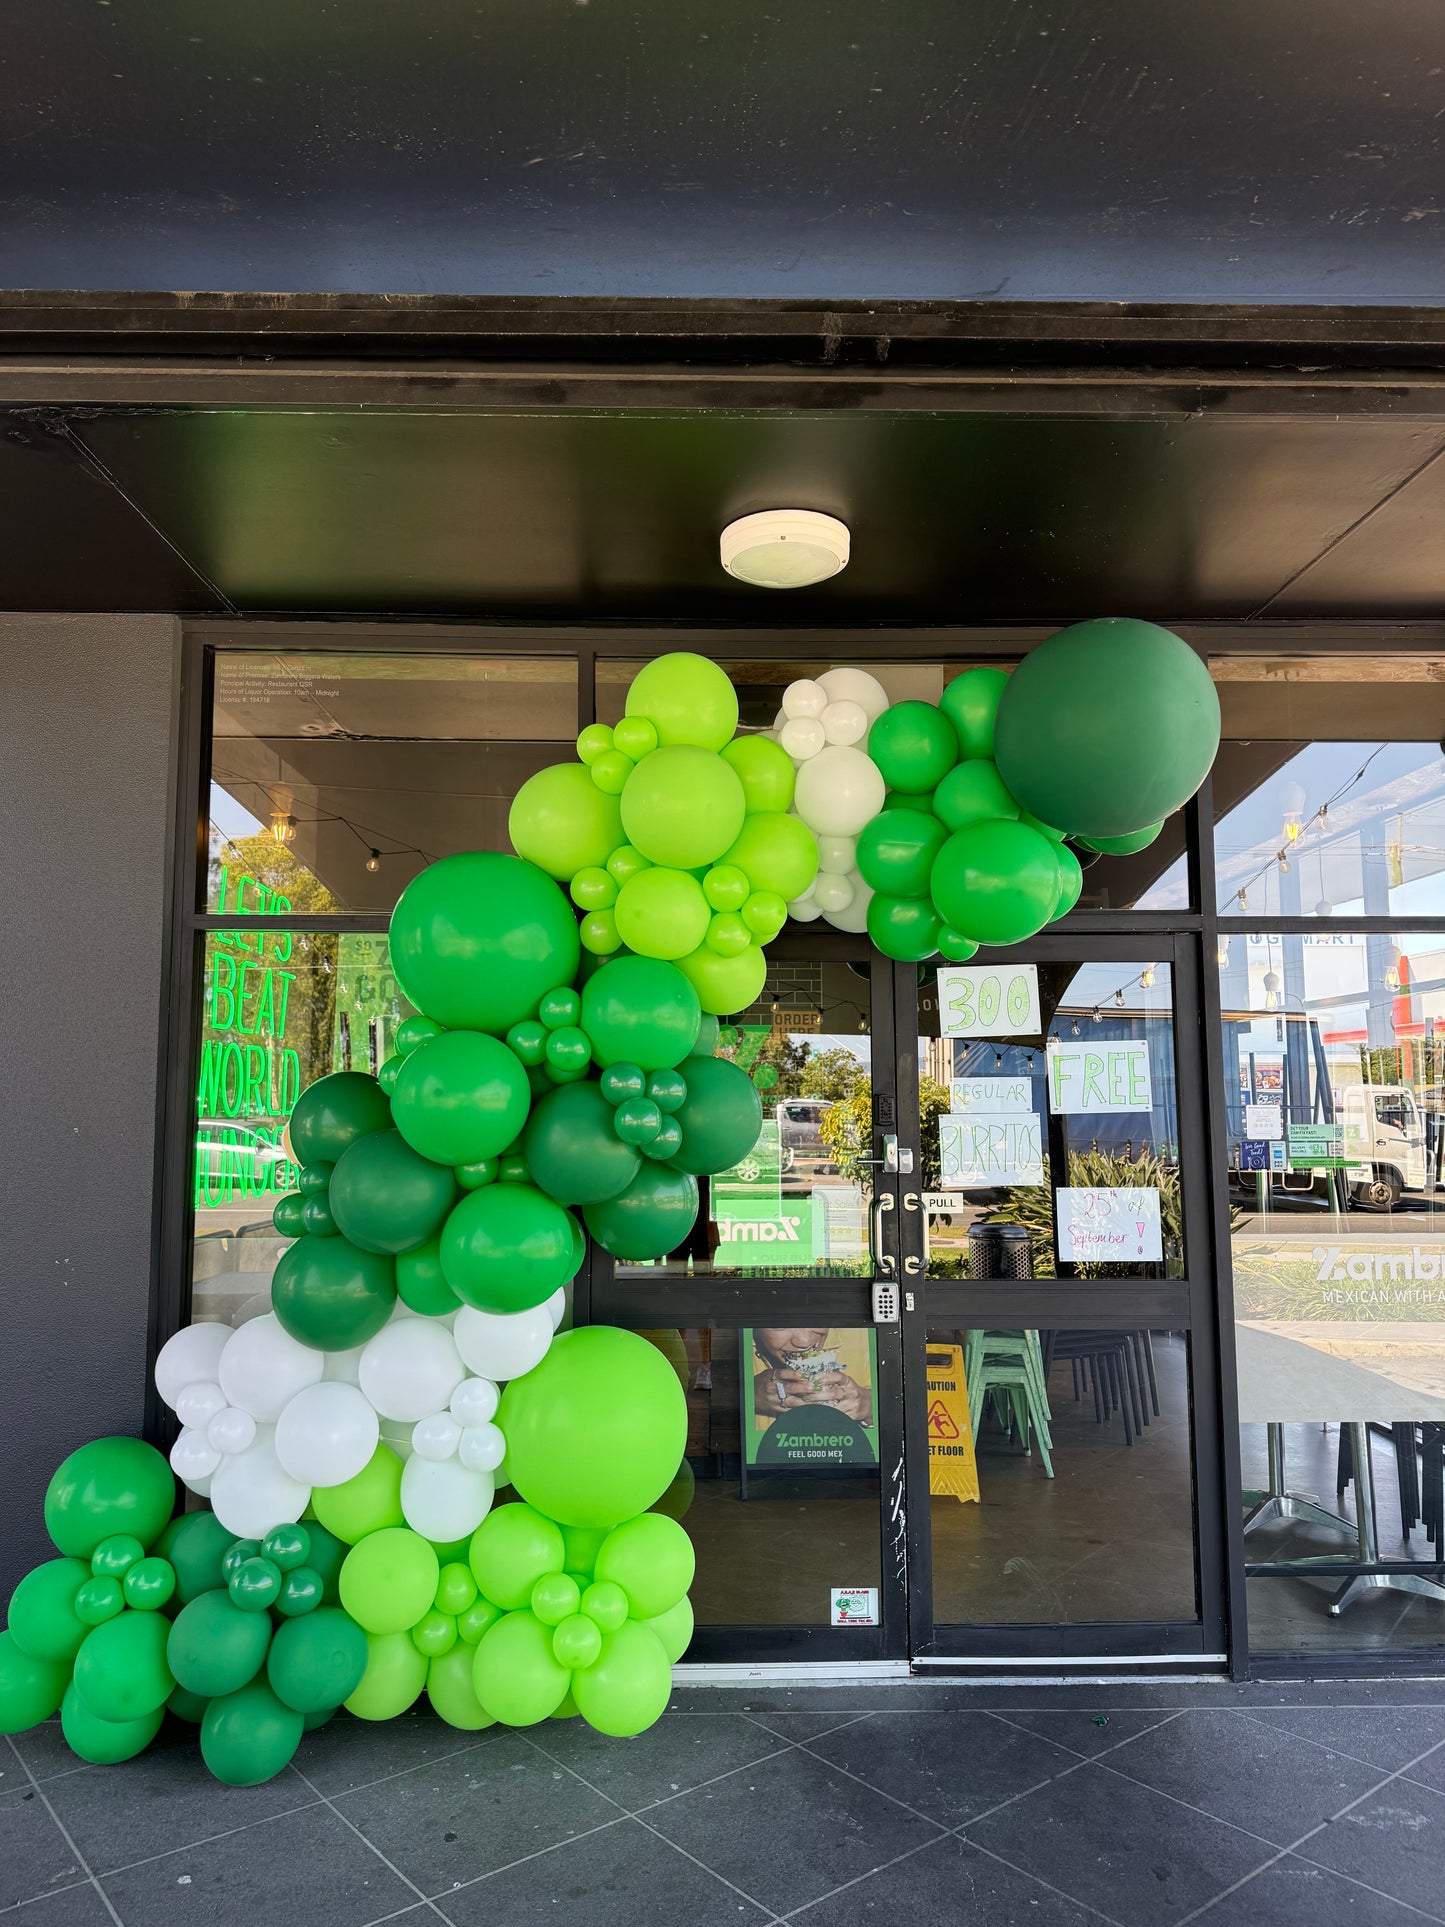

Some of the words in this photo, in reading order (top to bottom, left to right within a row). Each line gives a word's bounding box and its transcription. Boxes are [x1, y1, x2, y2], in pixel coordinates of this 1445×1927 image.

[211, 951, 297, 1039] BEAT
[945, 975, 1030, 1031] 300
[198, 1040, 300, 1118] WORLD
[1053, 1051, 1150, 1107] FREE
[953, 1083, 1027, 1105] REGULAR
[941, 1124, 1041, 1176] BURRITOS
[929, 1198, 956, 1207] PULL
[1067, 1224, 1129, 1248] September
[1312, 1246, 1445, 1280] Zamb
[1323, 1290, 1389, 1303] MEXICAN
[1394, 1290, 1432, 1303] WITH
[927, 1381, 957, 1392] AUTION
[776, 1433, 854, 1447] Zambrero
[938, 1446, 964, 1456] FLOOR
[788, 1450, 806, 1458] FEEL
[807, 1450, 827, 1458] GOOD
[828, 1450, 843, 1458] MEX
